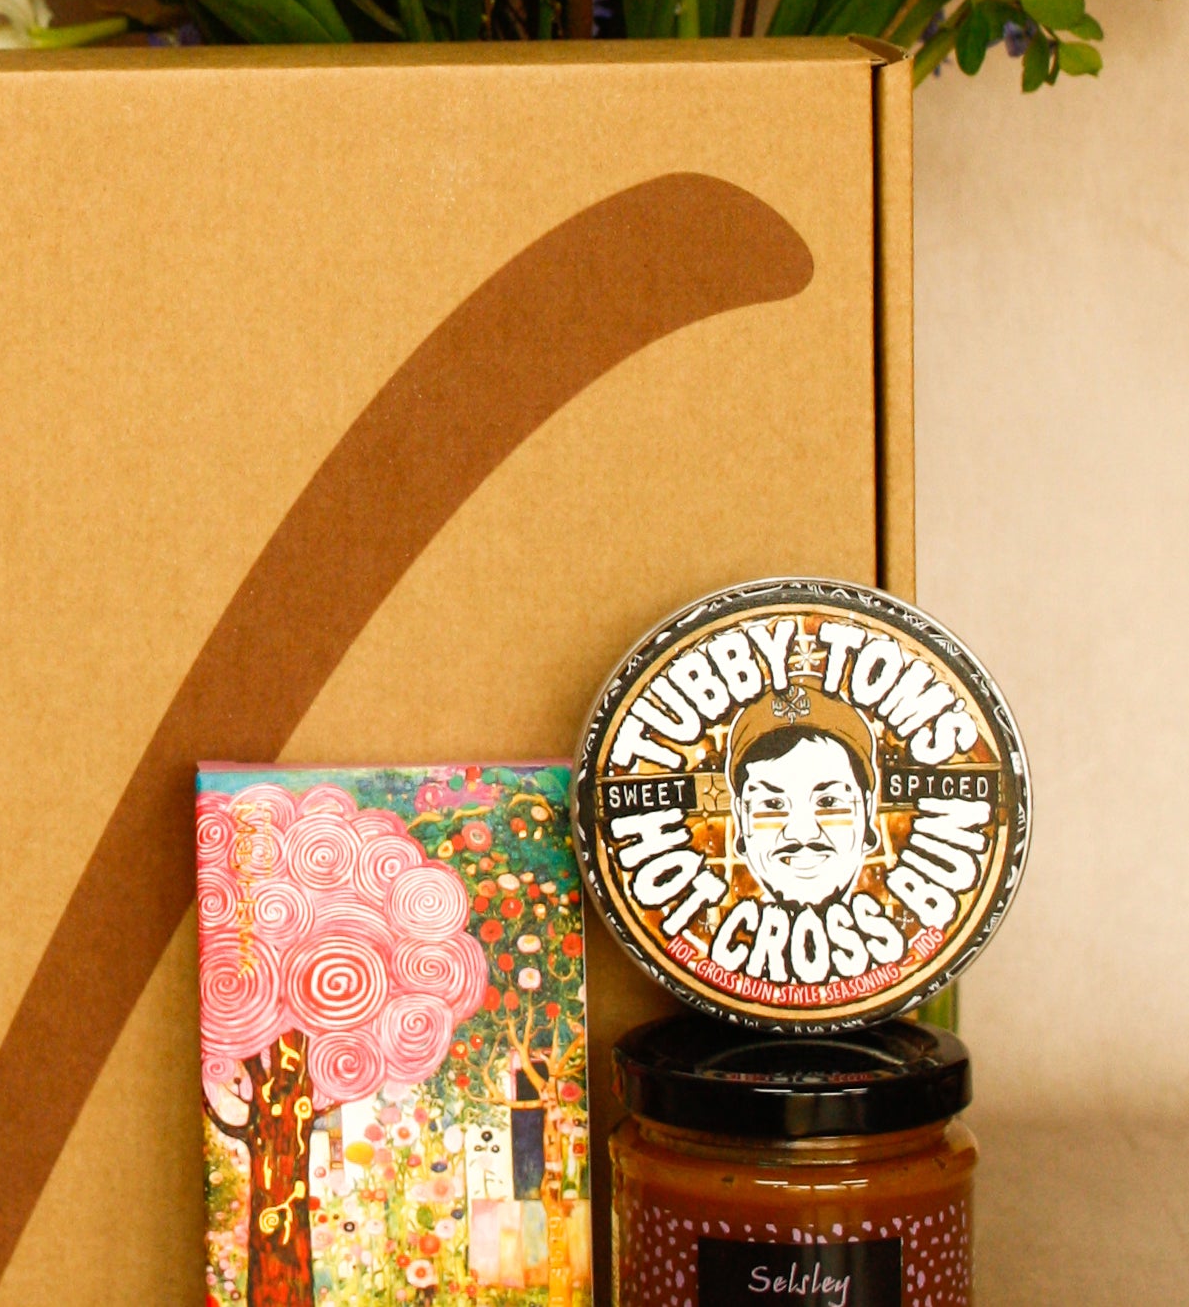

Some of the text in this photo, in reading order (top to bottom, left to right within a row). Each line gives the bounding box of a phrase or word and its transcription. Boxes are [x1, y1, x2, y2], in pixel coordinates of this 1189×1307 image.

[611, 619, 979, 770] TUBBY TOM'S
[608, 773, 990, 809] SWEET SPICED
[611, 796, 992, 984] HOT CROSS BUN
[668, 937, 693, 963] HOT
[695, 959, 739, 991] CROSS
[741, 978, 772, 1001] BUN
[779, 984, 820, 1004] STYLE
[825, 964, 900, 1002] SEASONING
[747, 1261, 850, 1307] Selsley
